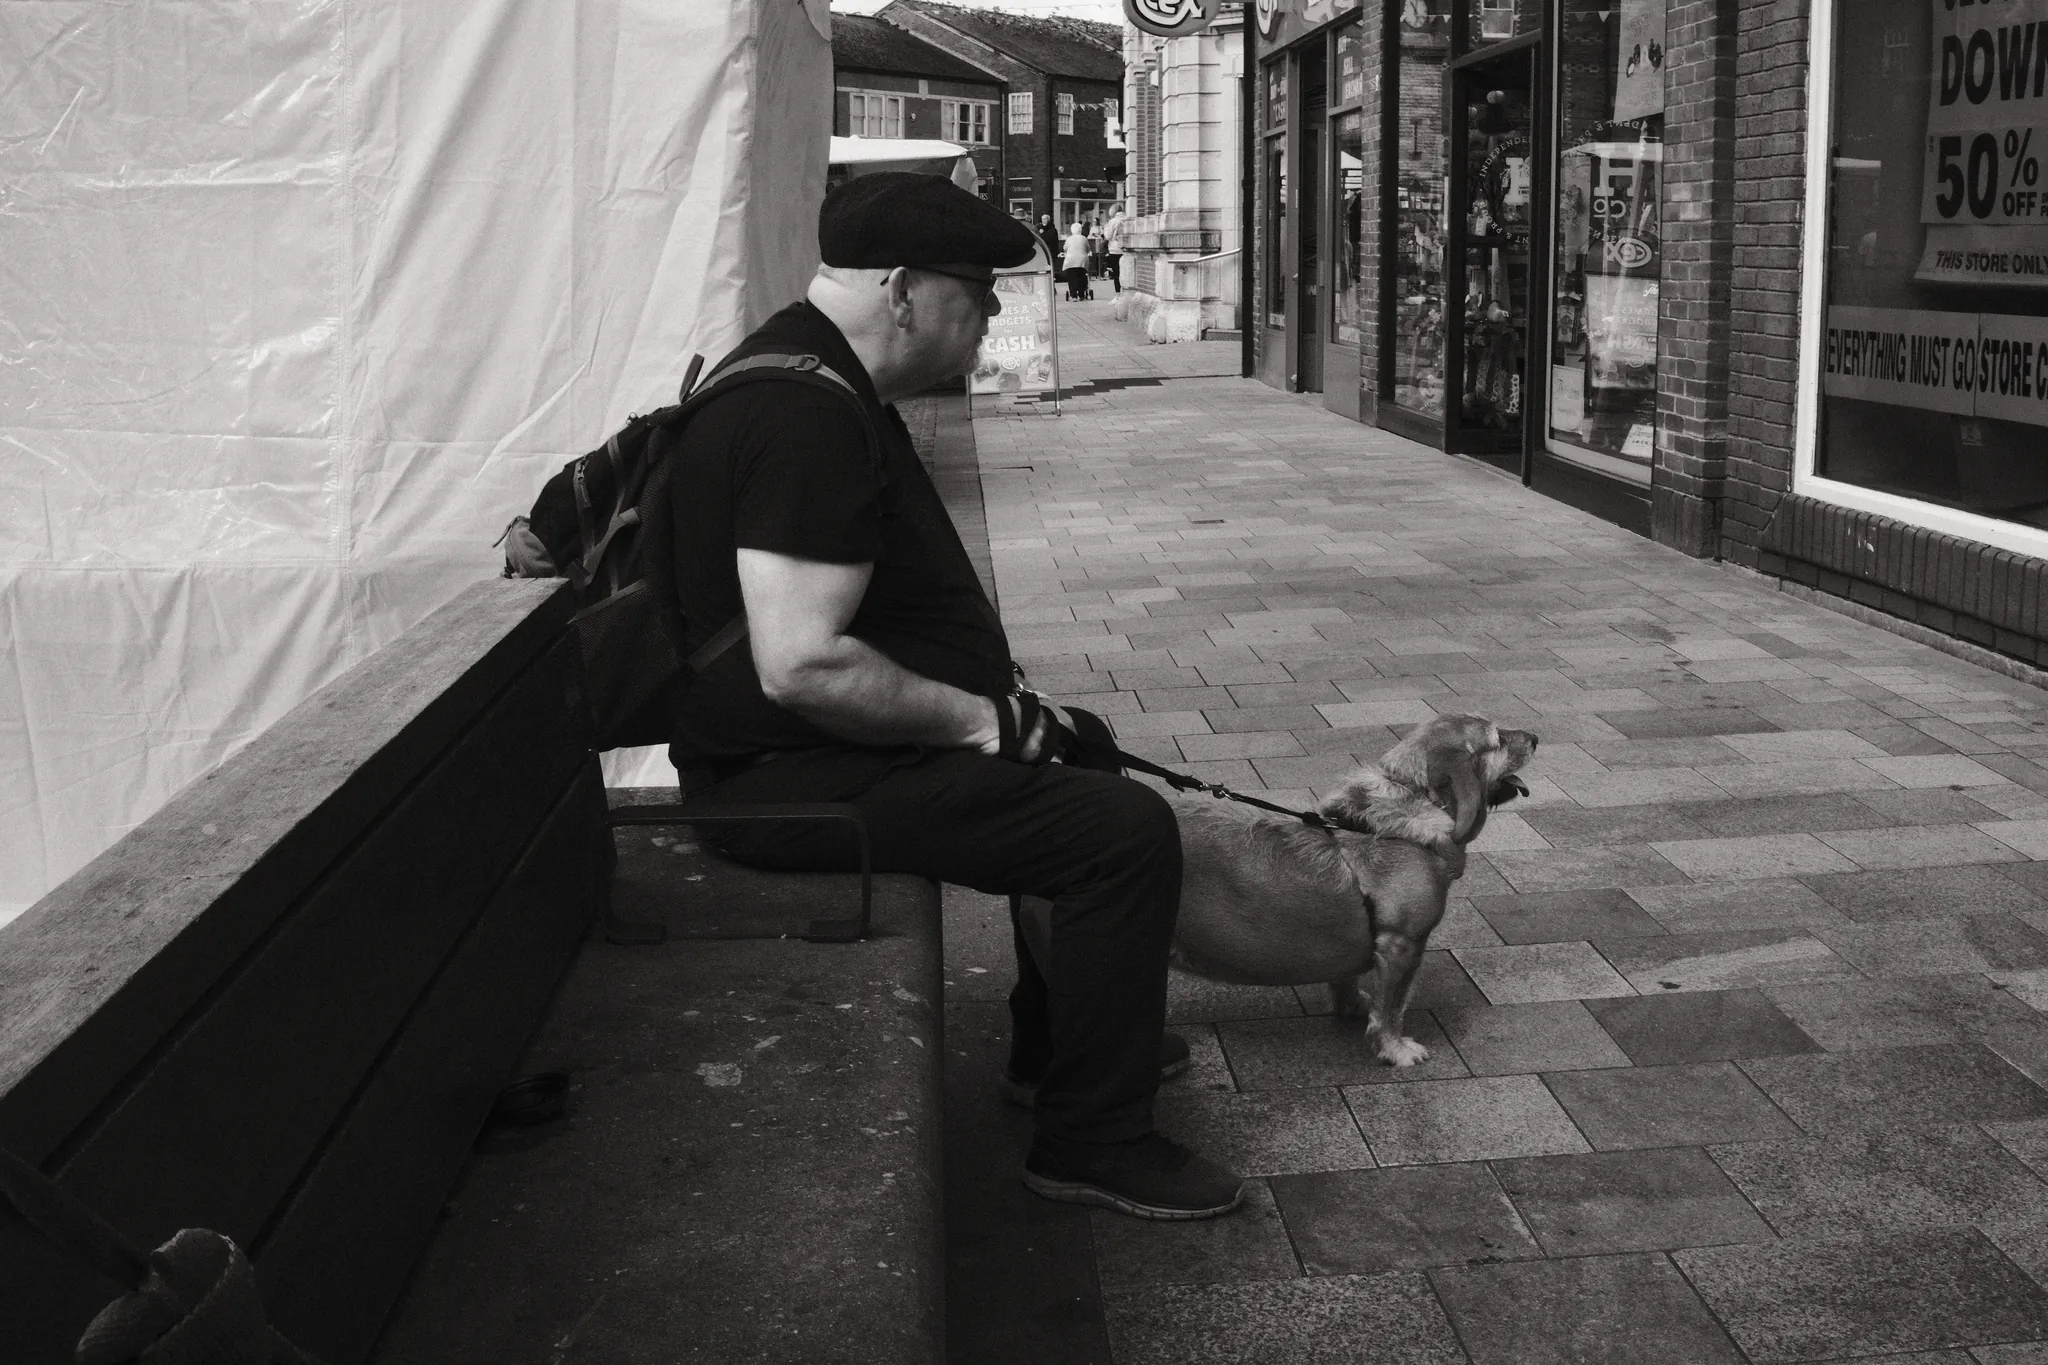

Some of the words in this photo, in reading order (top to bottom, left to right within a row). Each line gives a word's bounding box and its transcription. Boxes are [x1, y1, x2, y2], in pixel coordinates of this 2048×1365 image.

[1936, 127, 2039, 219] 50%
[2002, 191, 2038, 217] OFF
[1936, 251, 1963, 269] THIS
[1966, 252, 2009, 273] STORE
[1000, 305, 1021, 316] MES
[984, 334, 1036, 354] CASH
[1826, 328, 1906, 382] EVERYTHING
[1910, 334, 1951, 387] MUST
[1953, 337, 1976, 392] GO
[1979, 337, 2033, 397] STORE
